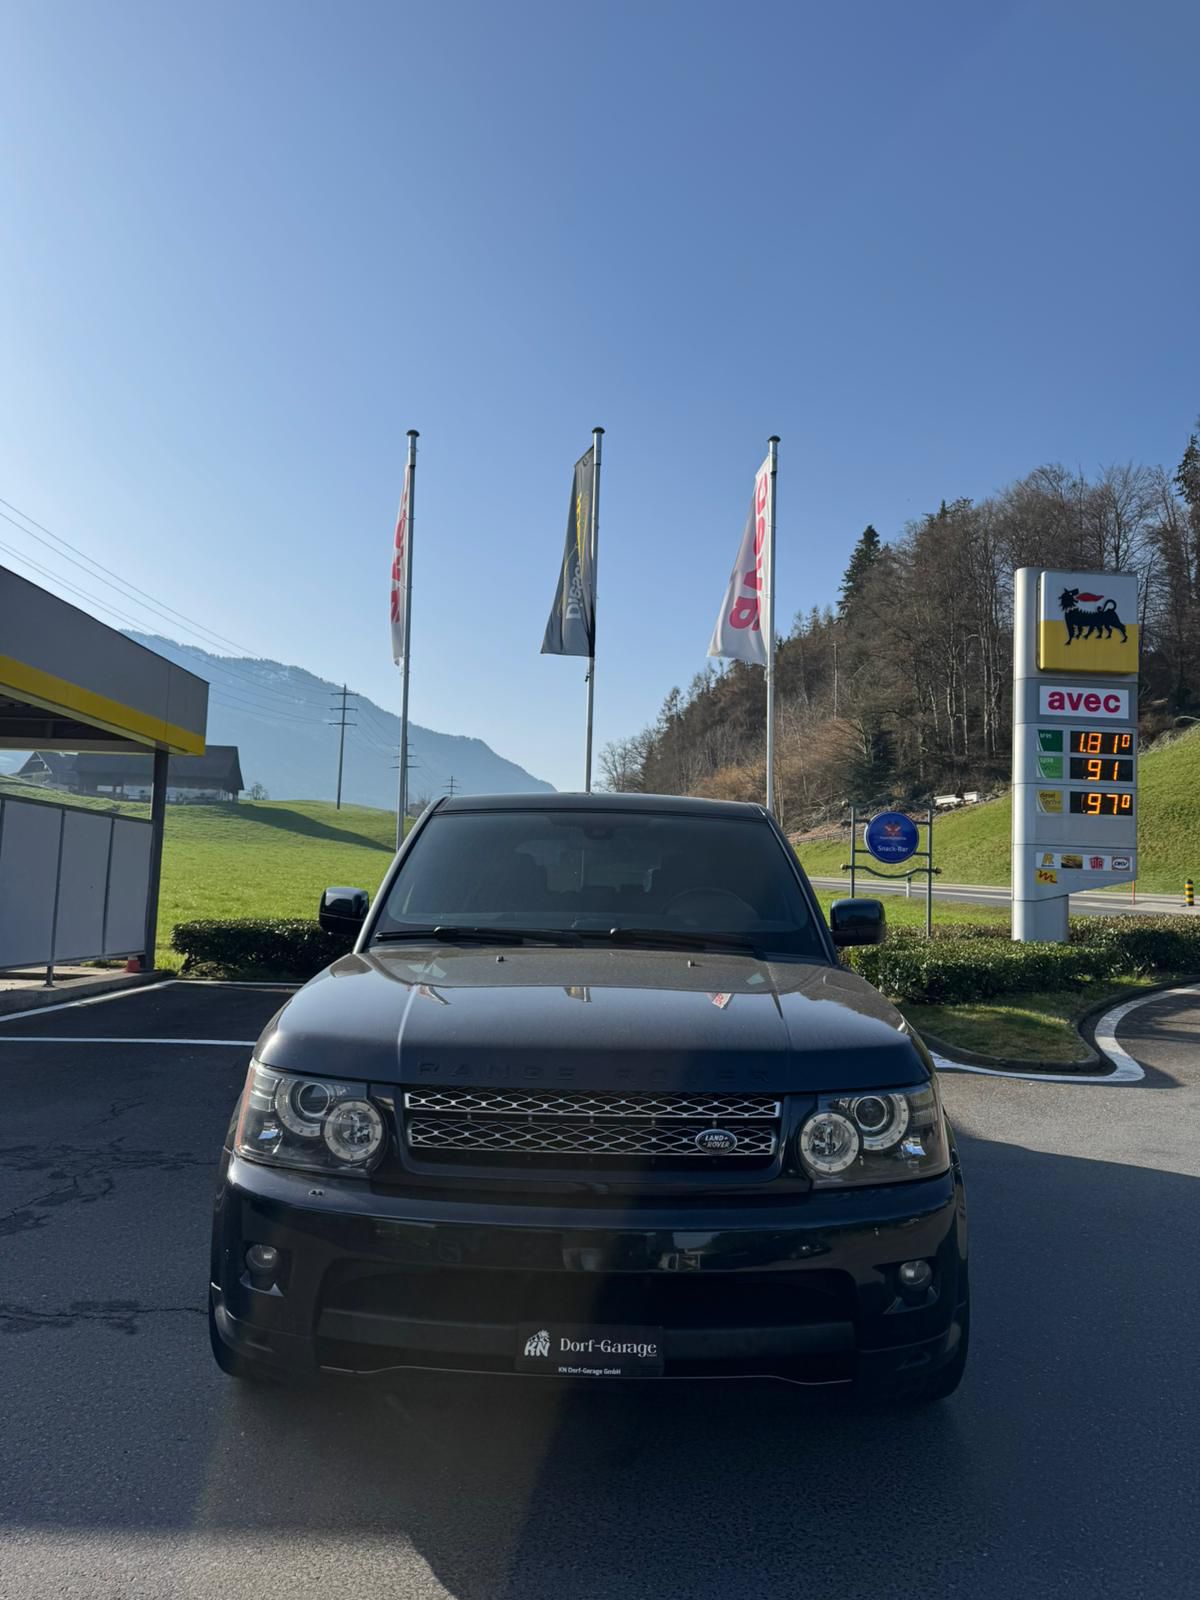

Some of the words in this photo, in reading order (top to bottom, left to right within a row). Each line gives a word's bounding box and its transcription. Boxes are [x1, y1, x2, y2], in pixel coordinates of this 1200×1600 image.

[1047, 690, 1121, 713] avec
[560, 1337, 657, 1357] Dorf-Garage
[568, 1367, 603, 1375] Dorf-Garage
